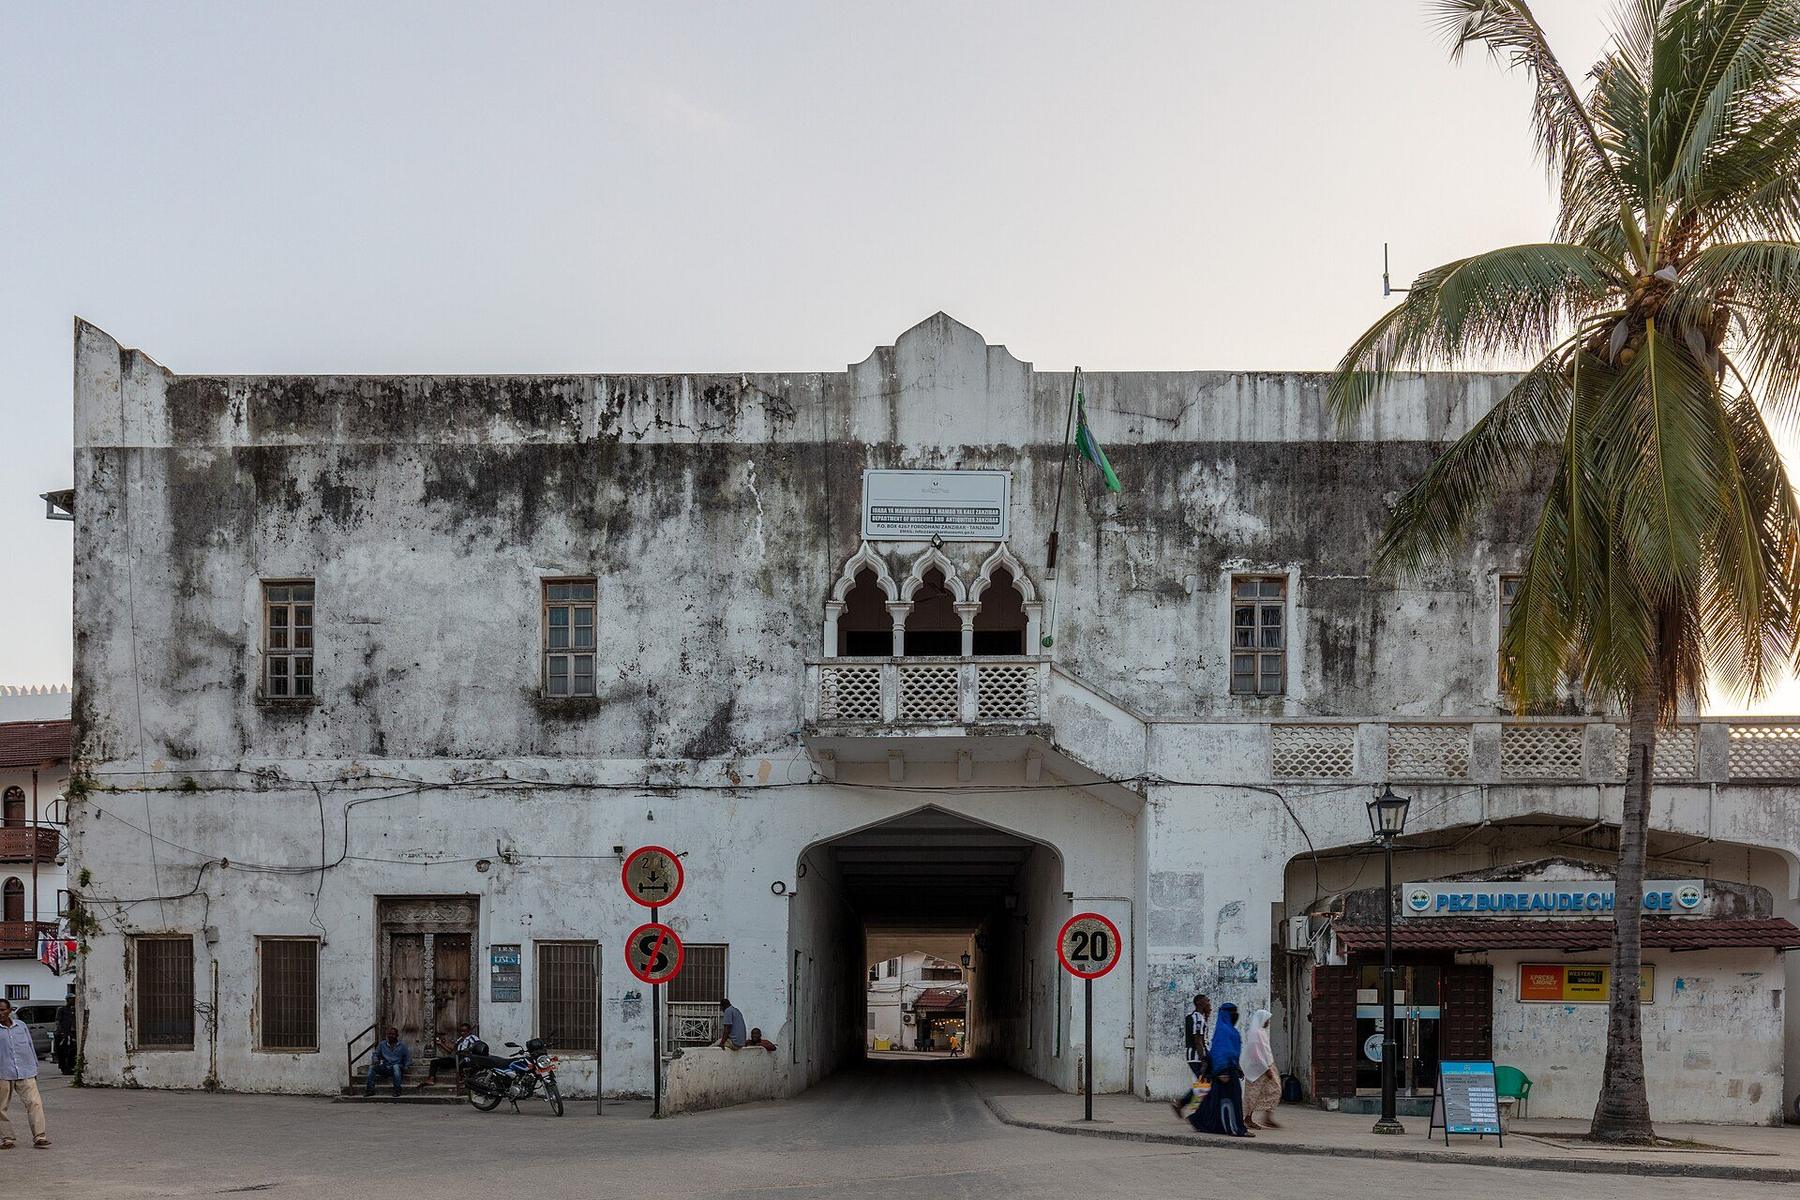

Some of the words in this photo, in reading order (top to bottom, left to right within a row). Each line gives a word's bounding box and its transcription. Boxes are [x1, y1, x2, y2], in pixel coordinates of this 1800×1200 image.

[641, 857, 649, 869] 2
[1436, 892, 1474, 912] PBZ
[1585, 890, 1673, 911] CHGE
[639, 934, 669, 973] S
[1071, 930, 1108, 961] 20
